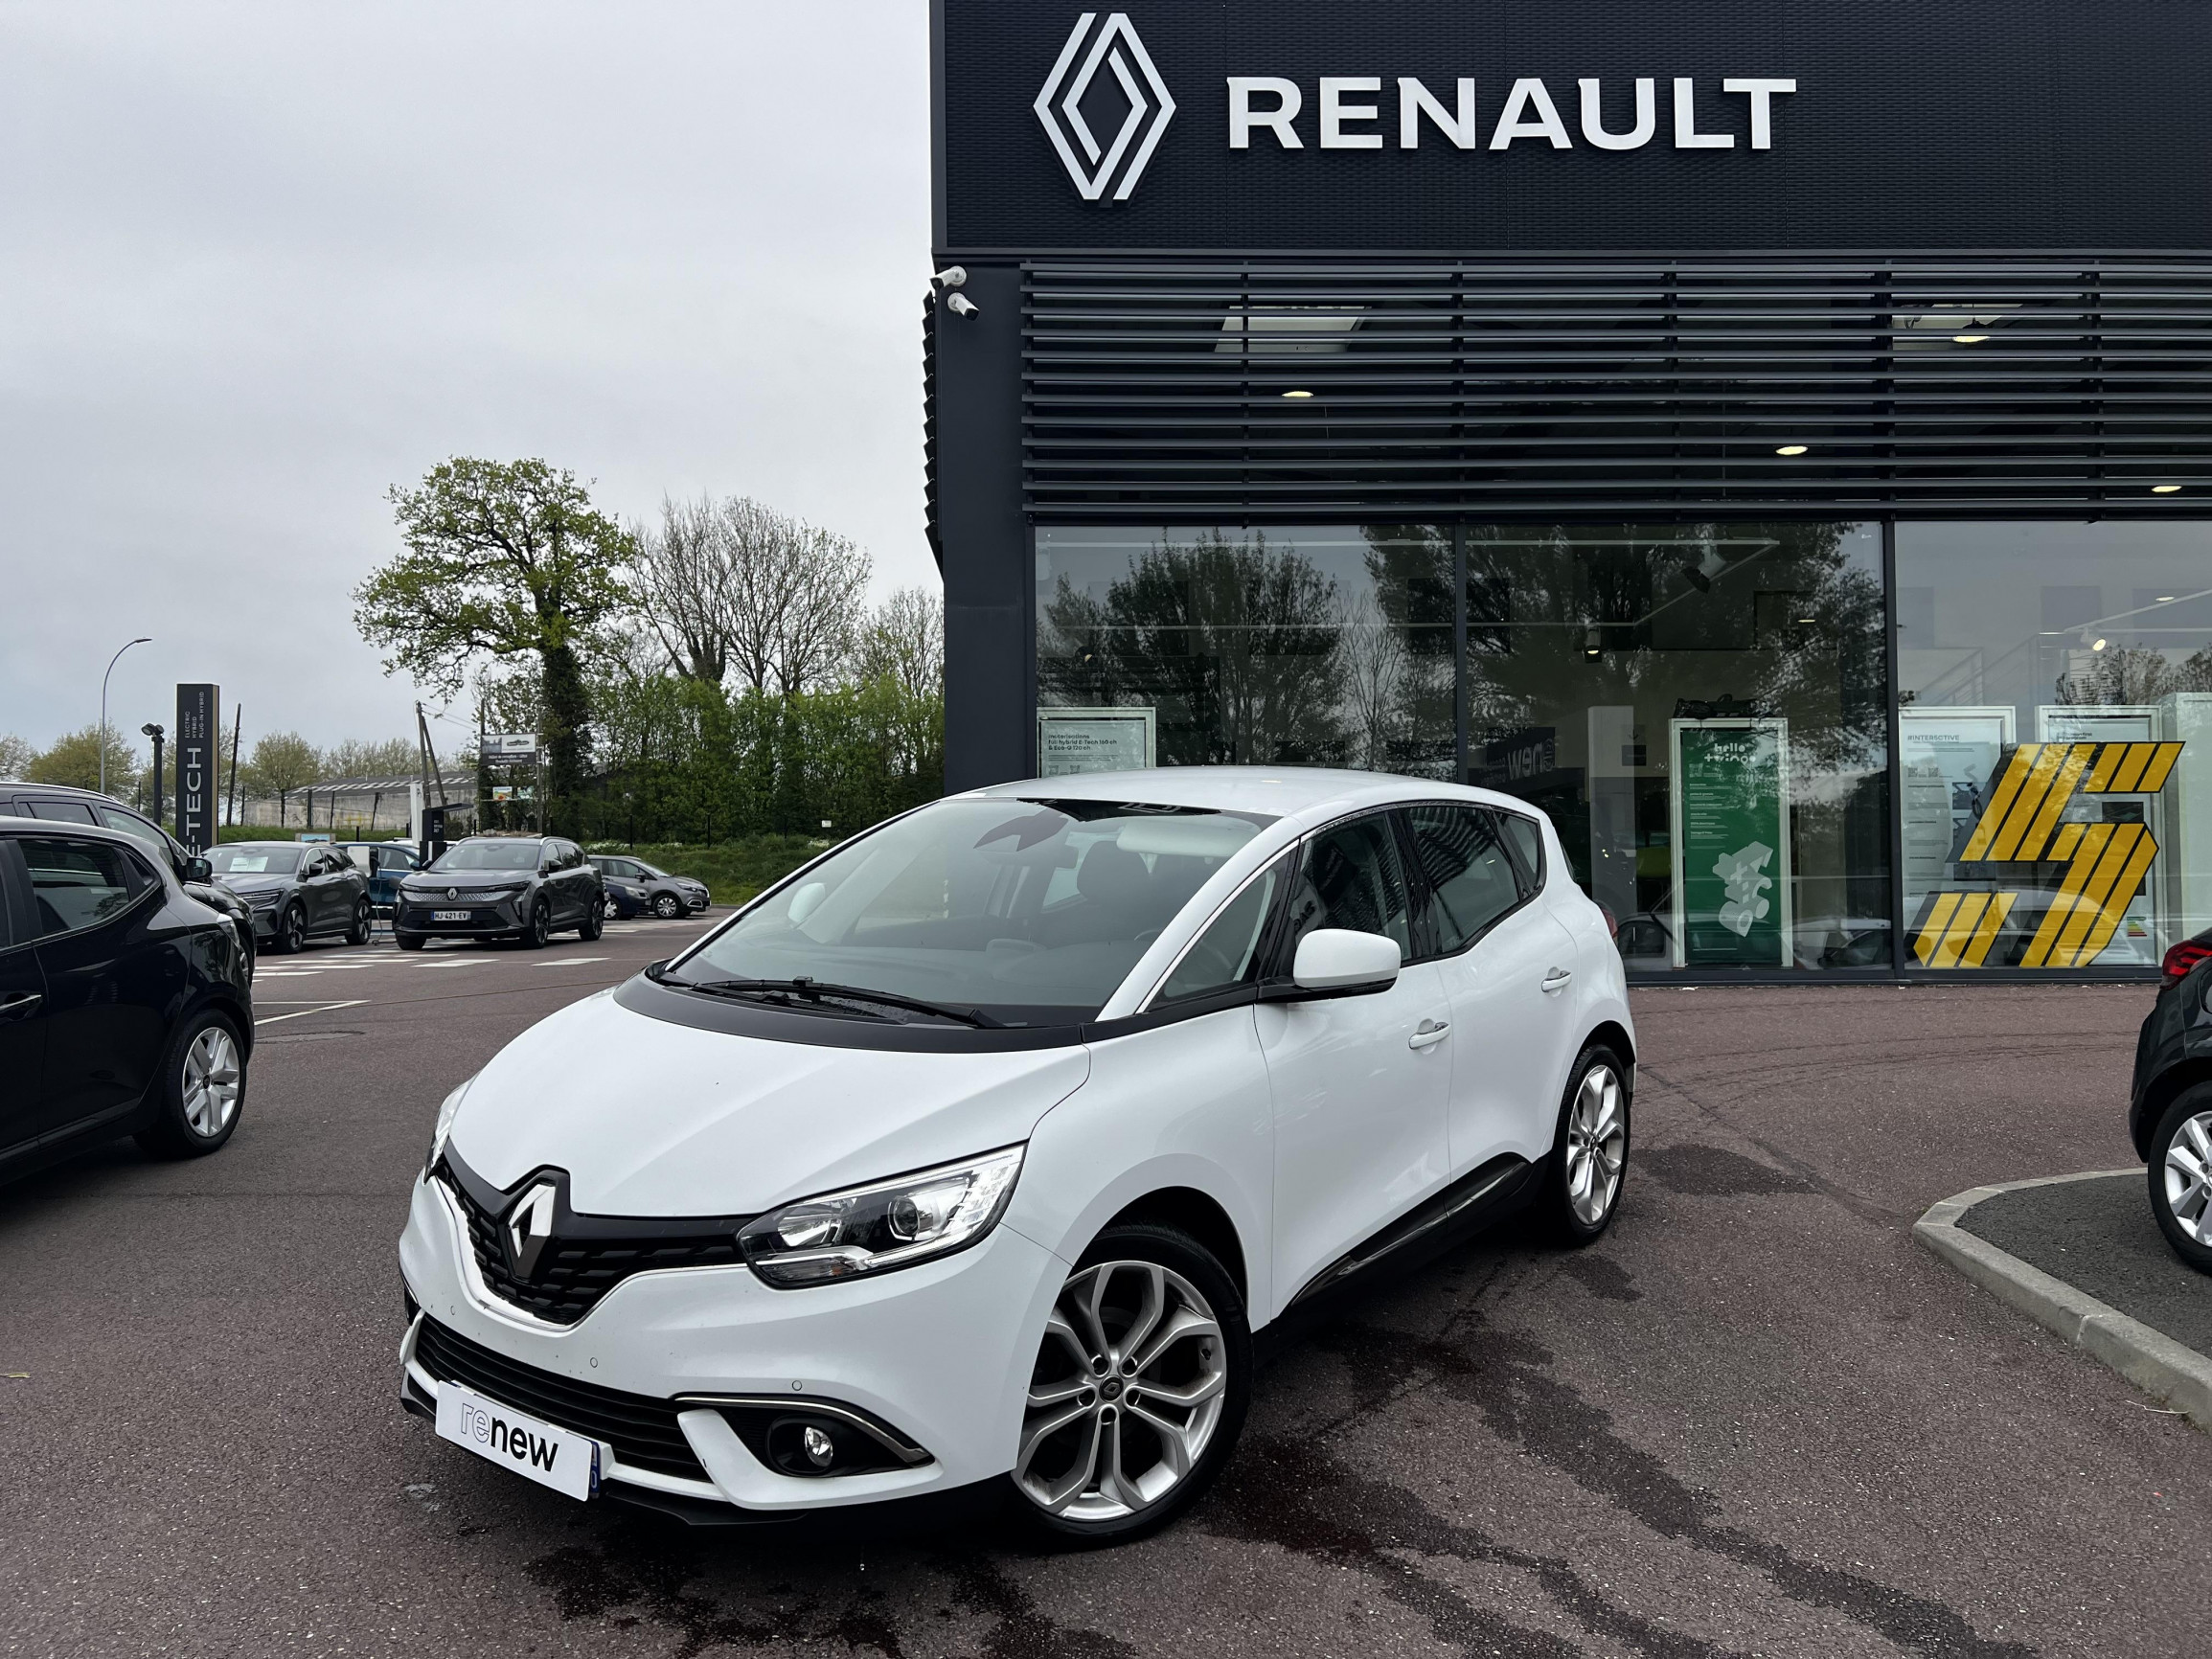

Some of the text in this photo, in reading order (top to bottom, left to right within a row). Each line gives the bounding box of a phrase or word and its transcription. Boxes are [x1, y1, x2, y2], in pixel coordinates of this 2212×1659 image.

[1226, 77, 1797, 150] RENAULT
[1714, 742, 1745, 752] hello
[461, 1403, 559, 1472] renew
